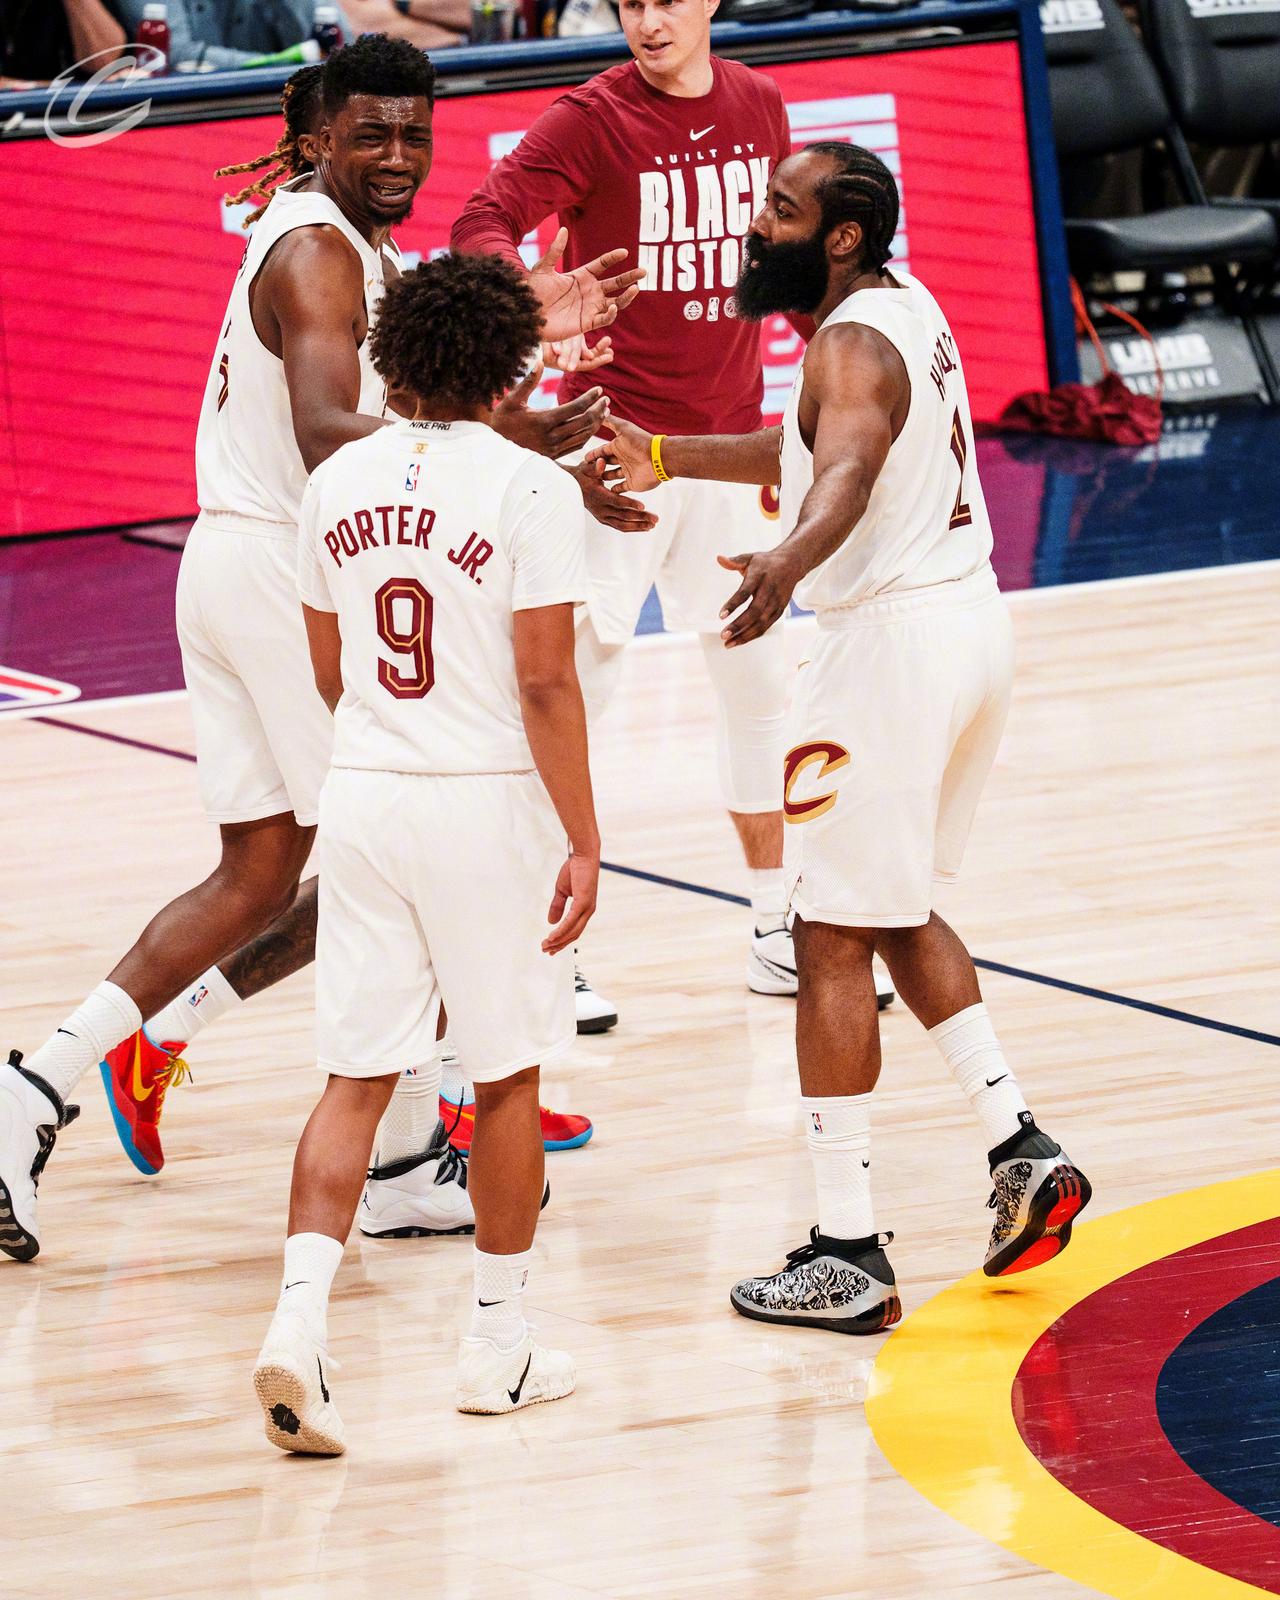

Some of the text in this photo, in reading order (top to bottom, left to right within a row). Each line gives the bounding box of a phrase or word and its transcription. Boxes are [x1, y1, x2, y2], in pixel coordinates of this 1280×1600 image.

[654, 143, 755, 165] BUILT BY
[638, 156, 771, 243] BLACK
[637, 238, 748, 292] HISTO
[1109, 333, 1212, 374] UMB
[409, 421, 452, 431] NIKE PRO
[324, 505, 494, 586] PORTER JR.
[375, 577, 435, 699] 9
[784, 740, 851, 825] C
